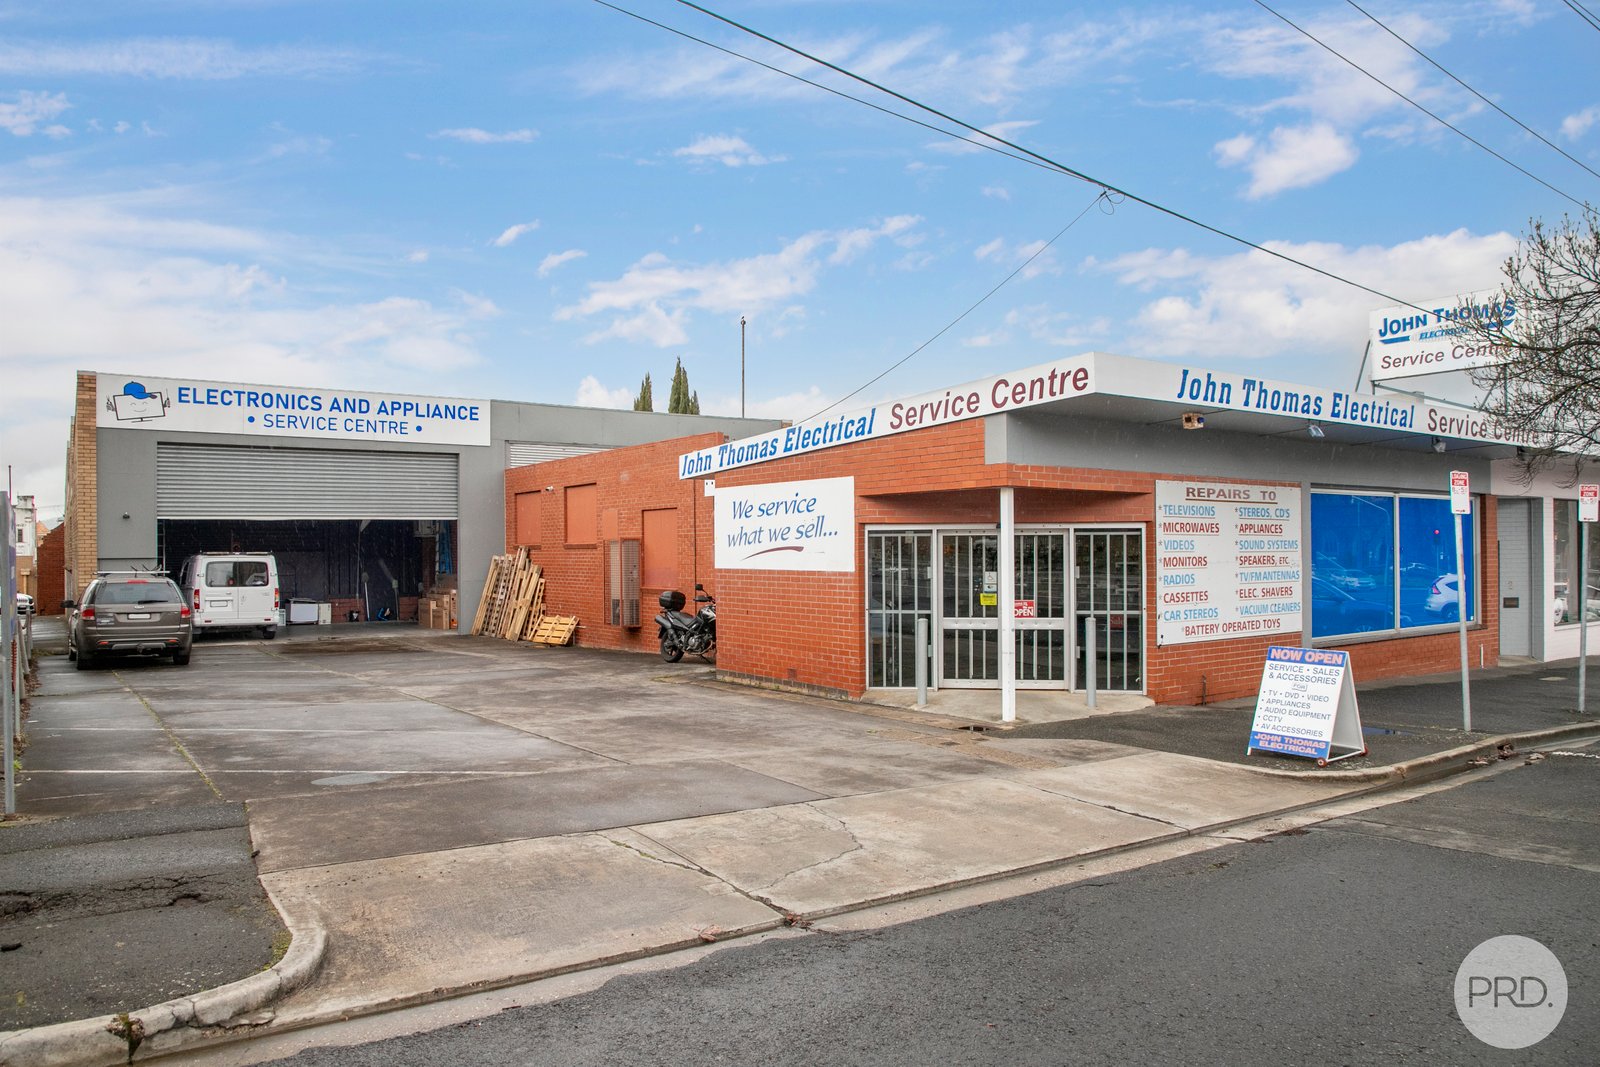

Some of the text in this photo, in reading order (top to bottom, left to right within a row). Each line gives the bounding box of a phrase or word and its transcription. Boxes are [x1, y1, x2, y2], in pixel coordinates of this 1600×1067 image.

[1378, 298, 1516, 338] JOHN THOMAS
[1381, 350, 1445, 369] Service
[177, 386, 480, 421] ELECTRONICS AND APPLIANCE
[1177, 369, 1539, 445] John Thomas Electrical Service Centre
[263, 412, 409, 435] SERVICE CENTRE
[681, 366, 1089, 477] John Thomas Electrical Service Centre
[1185, 487, 1277, 501] REPAIRS TO
[732, 492, 817, 520] We service
[1163, 505, 1215, 516] TELEVISIONS
[1238, 506, 1290, 518] STEREOS, CD'S
[726, 515, 838, 548] what we sell...
[1163, 522, 1220, 533] MICROWAVES
[1239, 523, 1283, 534] APPLIANCES
[1163, 539, 1195, 550] VIDEOS
[1239, 539, 1299, 550] SOUND SYSTEMS
[1163, 556, 1208, 568] MONITORS
[1239, 555, 1277, 566] SPEAKERS,
[1163, 573, 1195, 585] RADIOS
[1163, 591, 1209, 603] CASSETTES
[1239, 586, 1293, 598] ELEC. SHAVERS
[1163, 608, 1218, 621] CAR STEREOS
[1240, 602, 1301, 615] VACUUM CLEANERS
[1185, 618, 1281, 636] BATTERY OPERATED TOYS
[1271, 648, 1342, 664] NOW OPEN
[1268, 663, 1340, 677] SERVICE SALES
[1276, 673, 1337, 685] ACCESSORIES
[1265, 698, 1311, 709] APPLIANCES
[1306, 694, 1329, 703] VIDEO
[1262, 715, 1283, 723] CCTV
[1264, 706, 1331, 721] AUDIO EQUIPMENT
[1261, 722, 1323, 738] AV ACCESSORIES
[1254, 733, 1326, 749] JOHN THOMAS
[1259, 741, 1318, 755] ELECTRICAL
